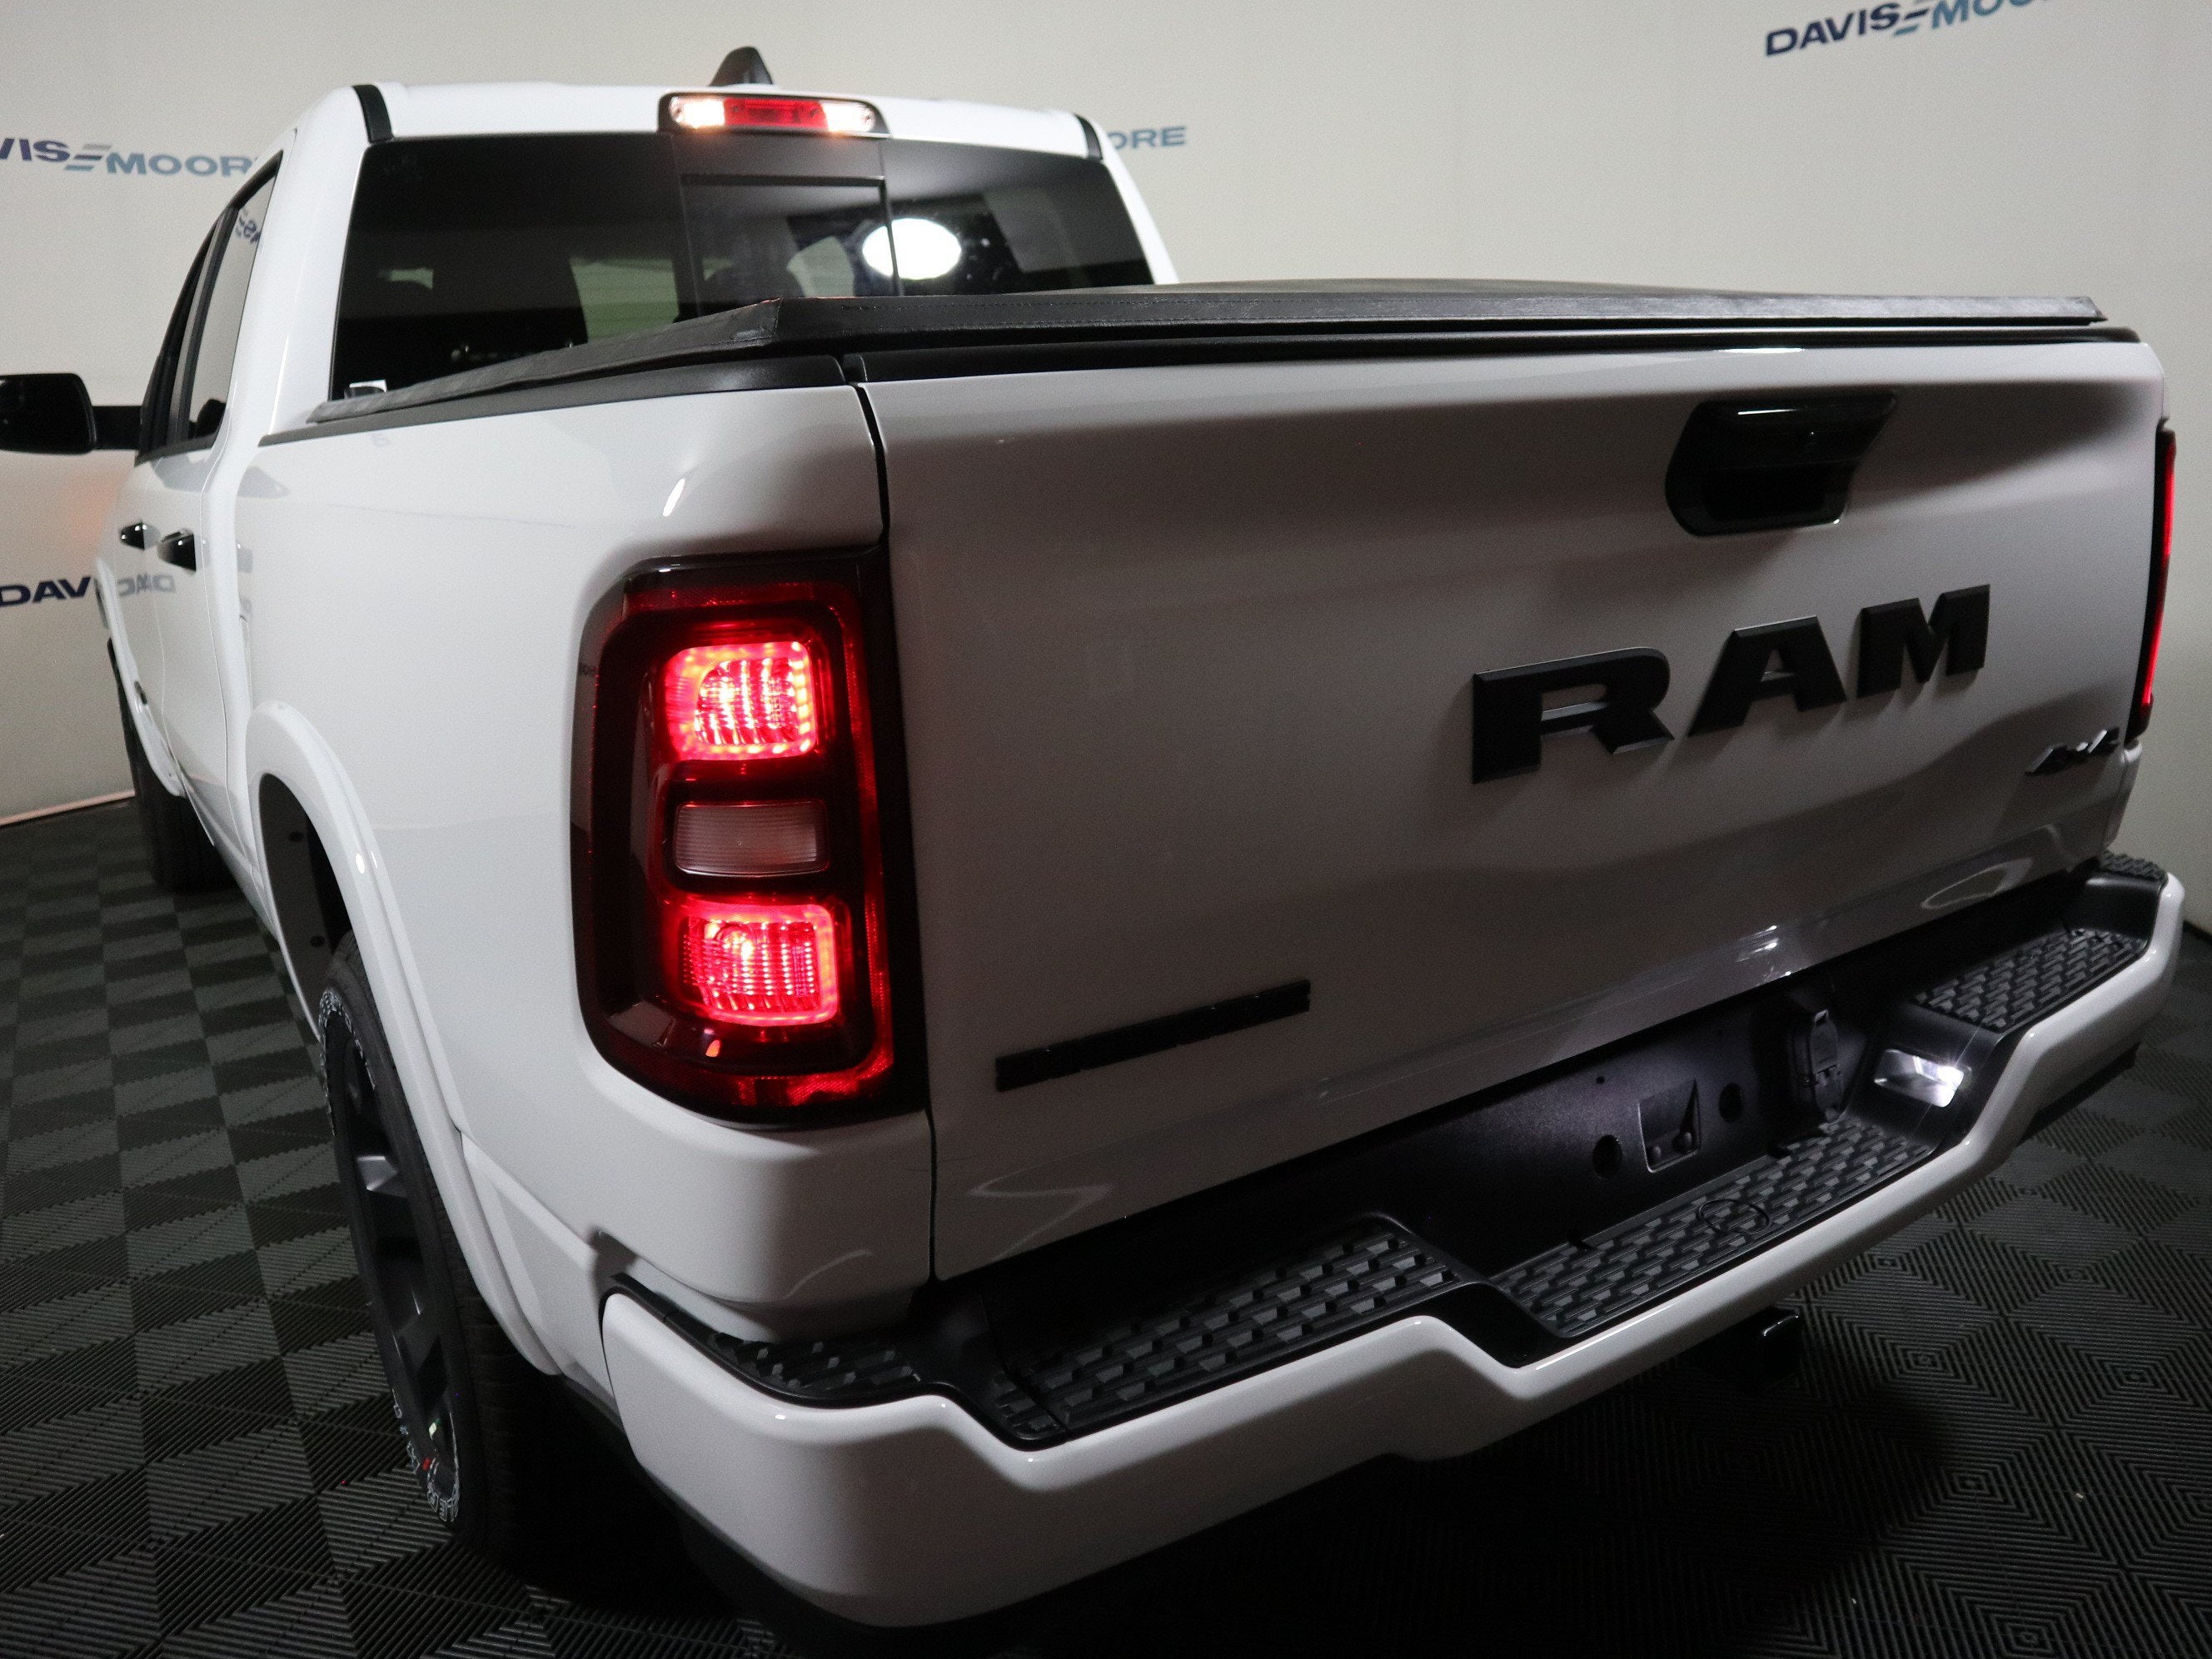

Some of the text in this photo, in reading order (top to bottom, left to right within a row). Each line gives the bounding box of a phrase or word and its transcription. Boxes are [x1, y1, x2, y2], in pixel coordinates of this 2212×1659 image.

[1766, 0, 2035, 56] DAVIS MO
[106, 152, 253, 177] MOOR
[1472, 584, 1990, 784] RAM
